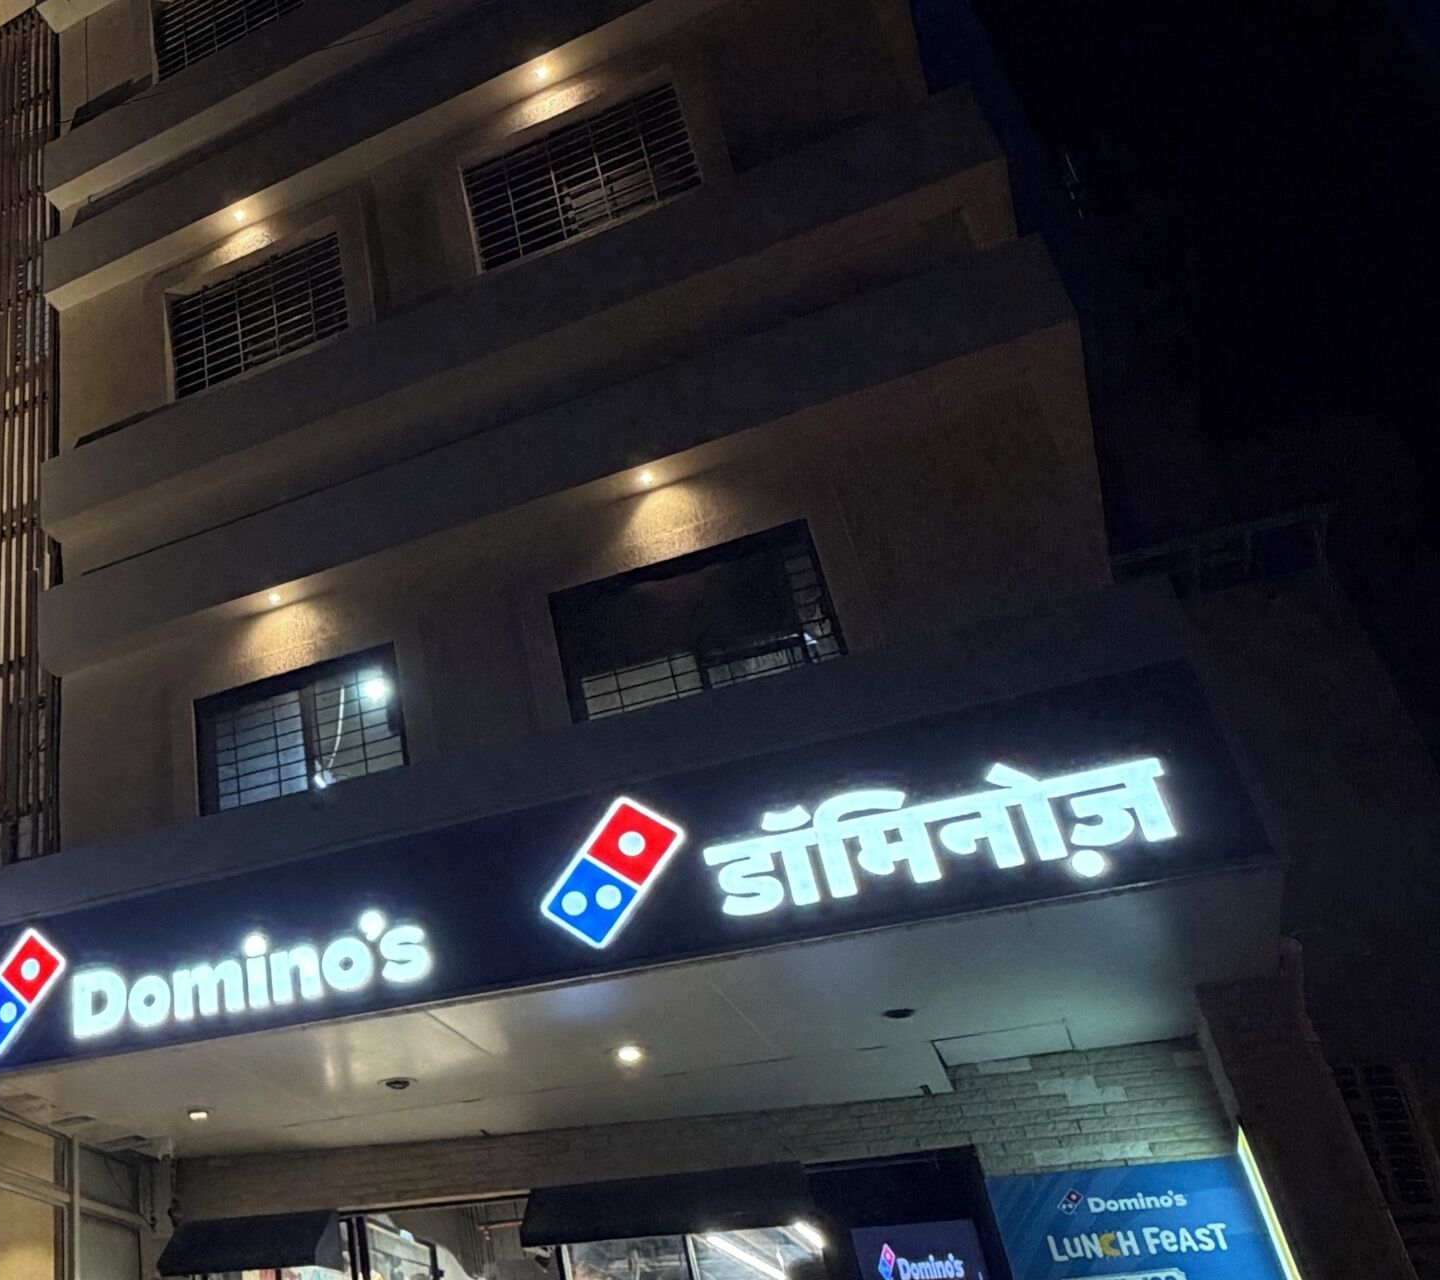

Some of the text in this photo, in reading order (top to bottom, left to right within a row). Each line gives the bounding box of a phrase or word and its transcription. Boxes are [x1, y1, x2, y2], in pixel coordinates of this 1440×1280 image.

[703, 756, 1178, 917] डॉमिनोज़
[72, 910, 431, 1038] Domino's
[1086, 1190, 1188, 1213] Domino's
[896, 1253, 965, 1280] Domino's
